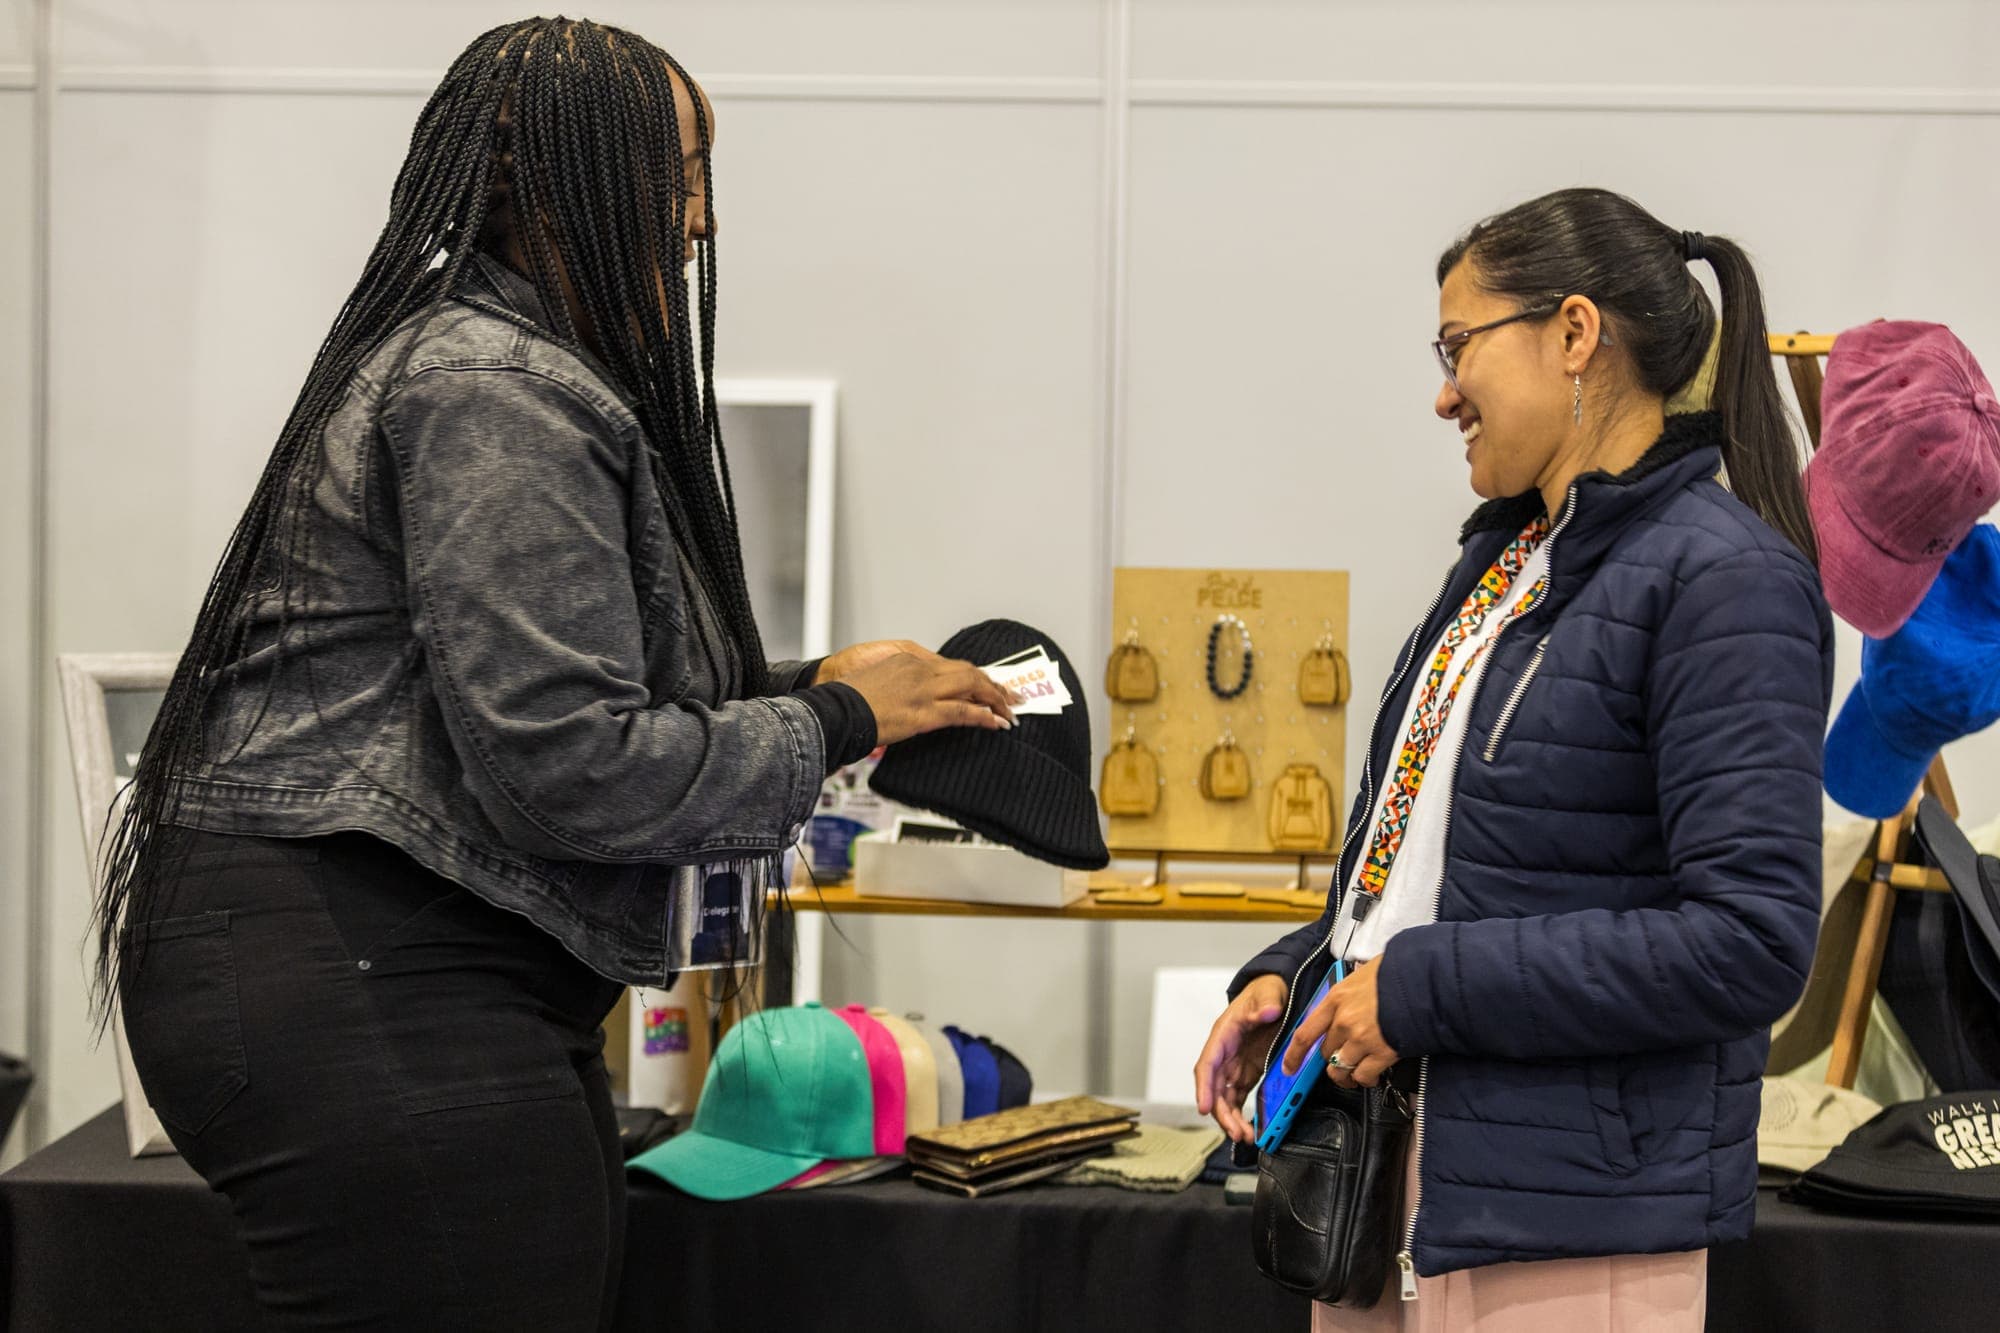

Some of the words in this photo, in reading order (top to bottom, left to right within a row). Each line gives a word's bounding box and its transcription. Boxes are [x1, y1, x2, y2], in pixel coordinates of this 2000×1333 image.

[1019, 681, 1055, 701] AN
[1926, 1101, 1986, 1126] WALK
[1947, 1143, 2000, 1170] NES
